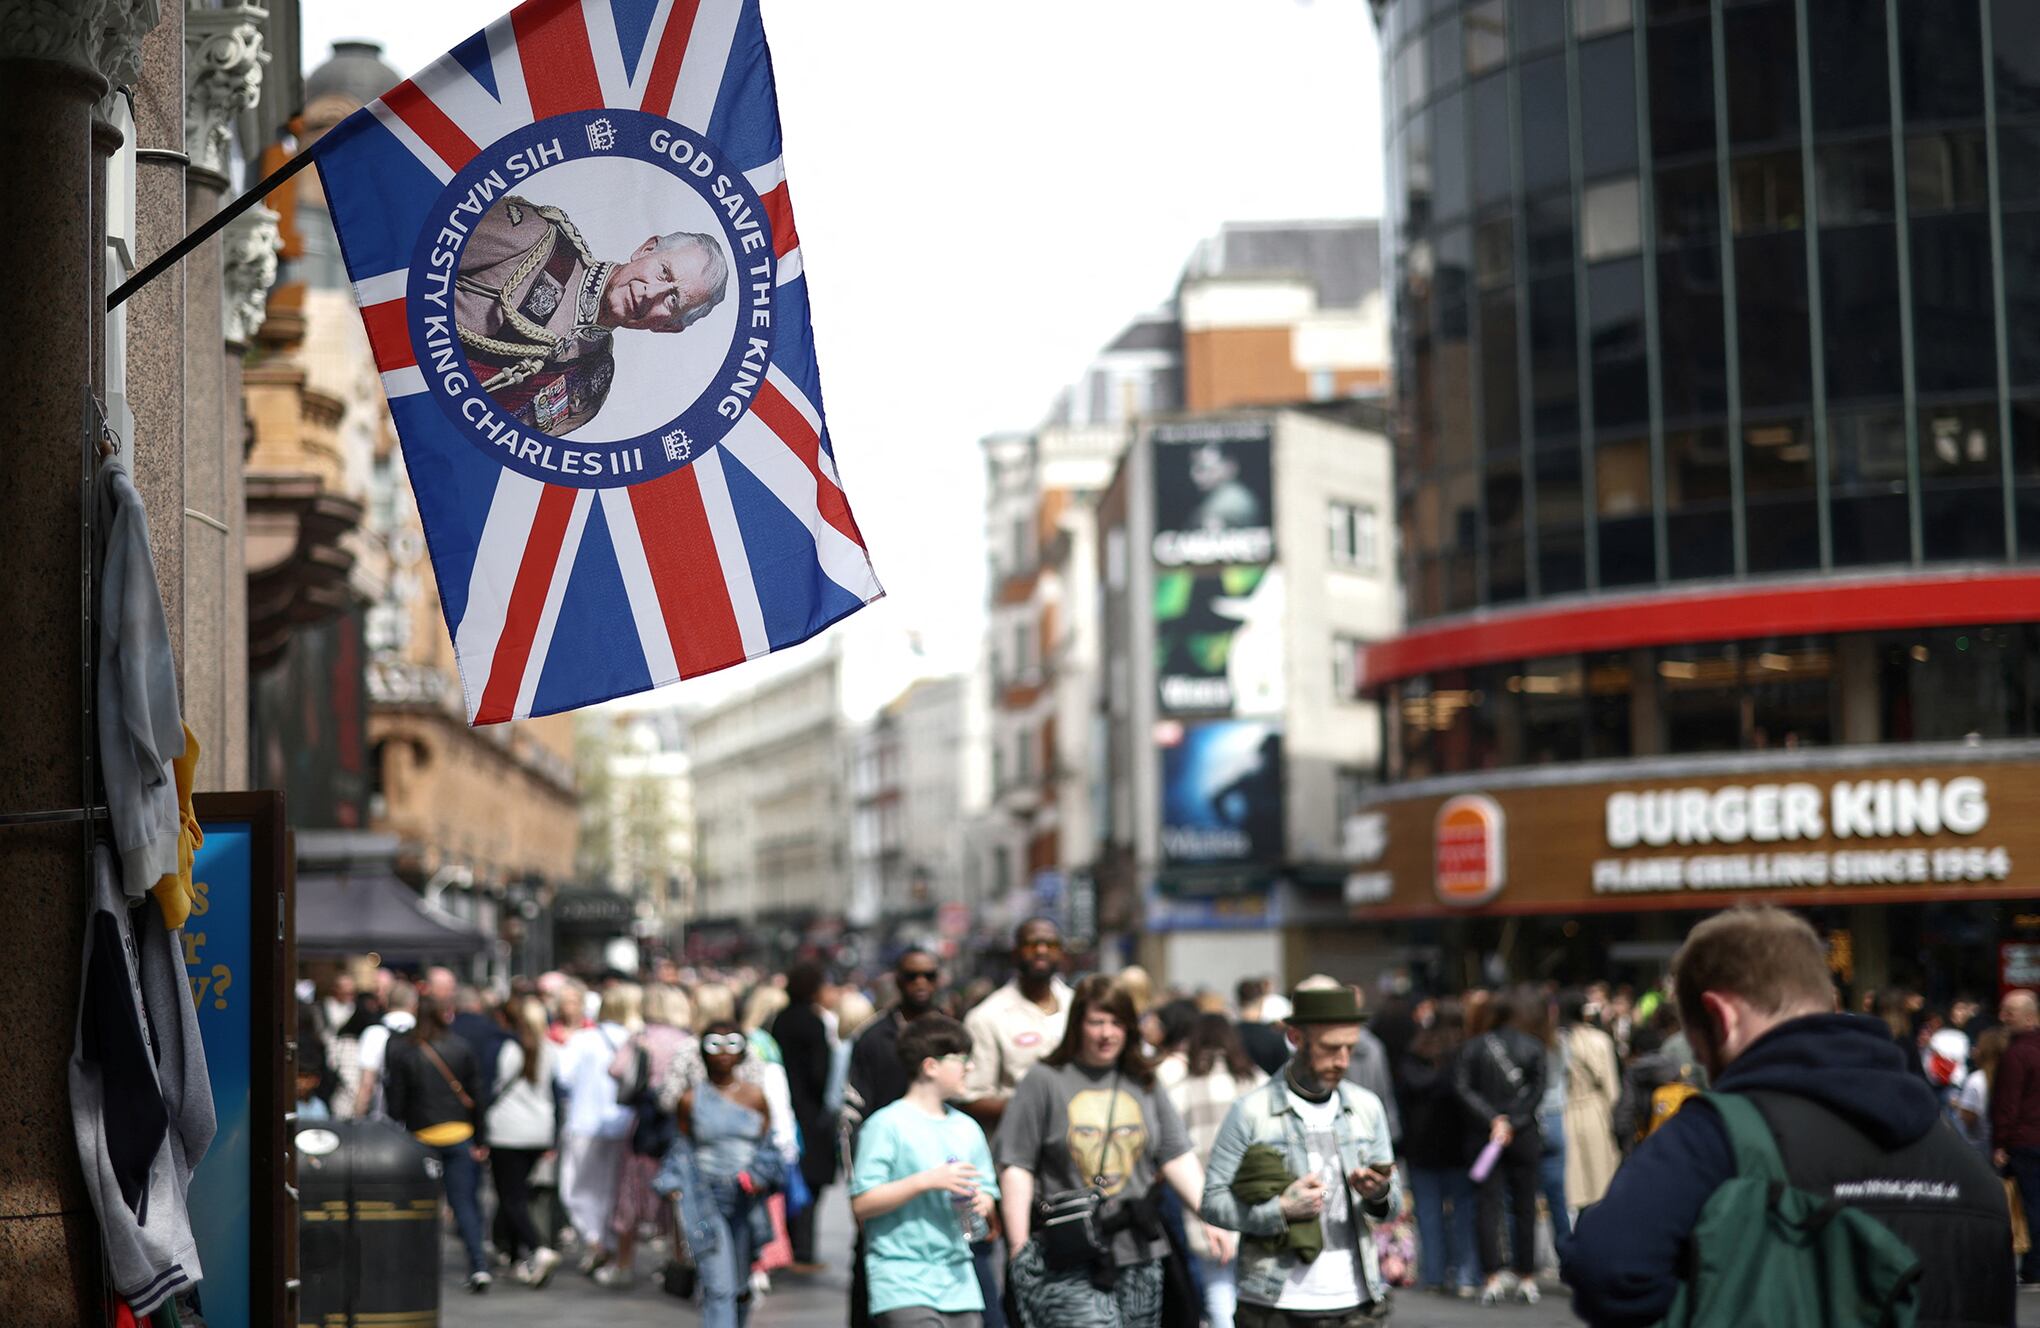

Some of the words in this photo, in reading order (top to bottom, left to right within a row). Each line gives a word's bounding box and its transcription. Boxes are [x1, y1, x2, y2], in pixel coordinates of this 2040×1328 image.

[505, 137, 565, 180] HIS
[650, 129, 714, 178] GOD
[423, 169, 509, 310] MAJESTY
[711, 174, 767, 255] SAVE
[749, 256, 771, 328] THE
[423, 315, 469, 397] KING
[717, 337, 769, 421] KING
[461, 397, 603, 476] CHARLES
[610, 448, 644, 476] III
[1606, 786, 1825, 847] BURGER
[1830, 776, 1989, 837] KING
[1593, 858, 1684, 891] FLAME
[1686, 852, 1828, 889] GRILLING
[1830, 848, 1929, 885] SINCE
[1931, 846, 2011, 881] 1954
